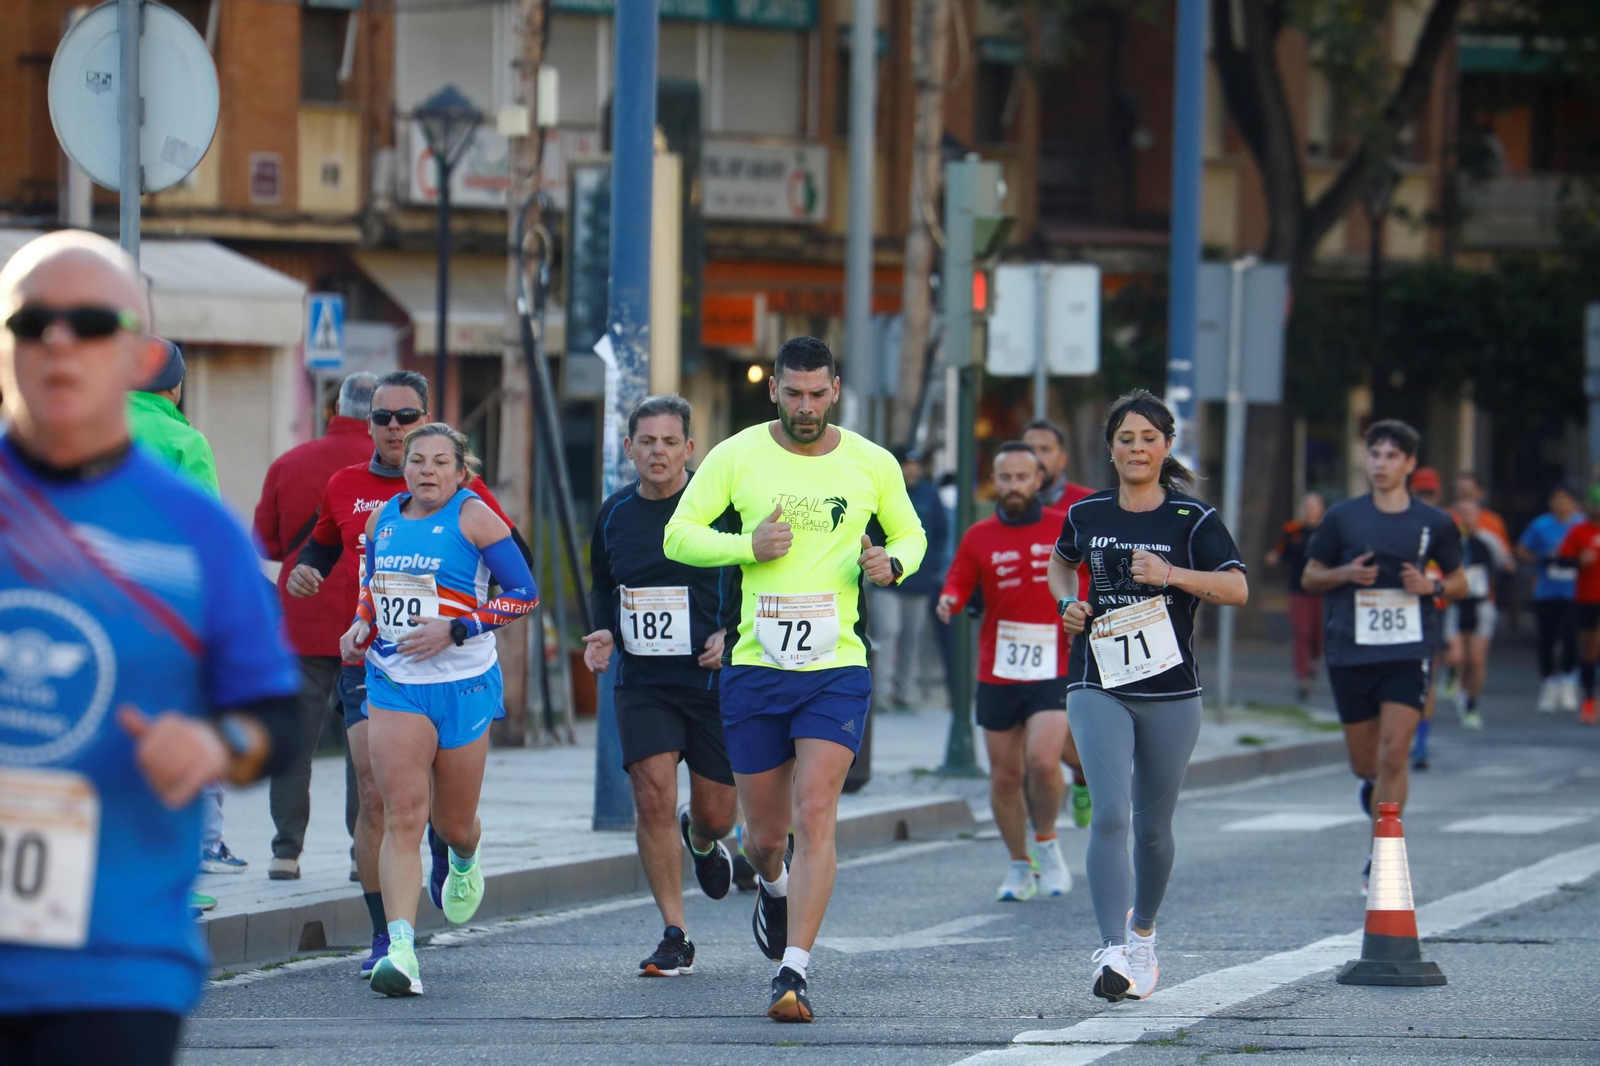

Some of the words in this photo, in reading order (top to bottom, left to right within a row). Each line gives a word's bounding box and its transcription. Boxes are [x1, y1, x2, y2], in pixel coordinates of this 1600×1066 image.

[778, 494, 822, 513] TRAIL
[782, 508, 810, 518] ESAFÍO
[785, 516, 799, 524] DEL
[802, 518, 829, 528] GALLO
[793, 525, 828, 533] ZOBLANCO
[1113, 542, 1171, 552] ANIVERSARIO
[758, 596, 779, 618] XLI
[1099, 595, 1116, 605] SAN
[381, 596, 421, 627] 329
[1368, 608, 1406, 631] 285
[629, 612, 672, 639] 182
[778, 620, 812, 652] 72
[1007, 643, 1043, 667] 378
[1114, 630, 1151, 665] 71
